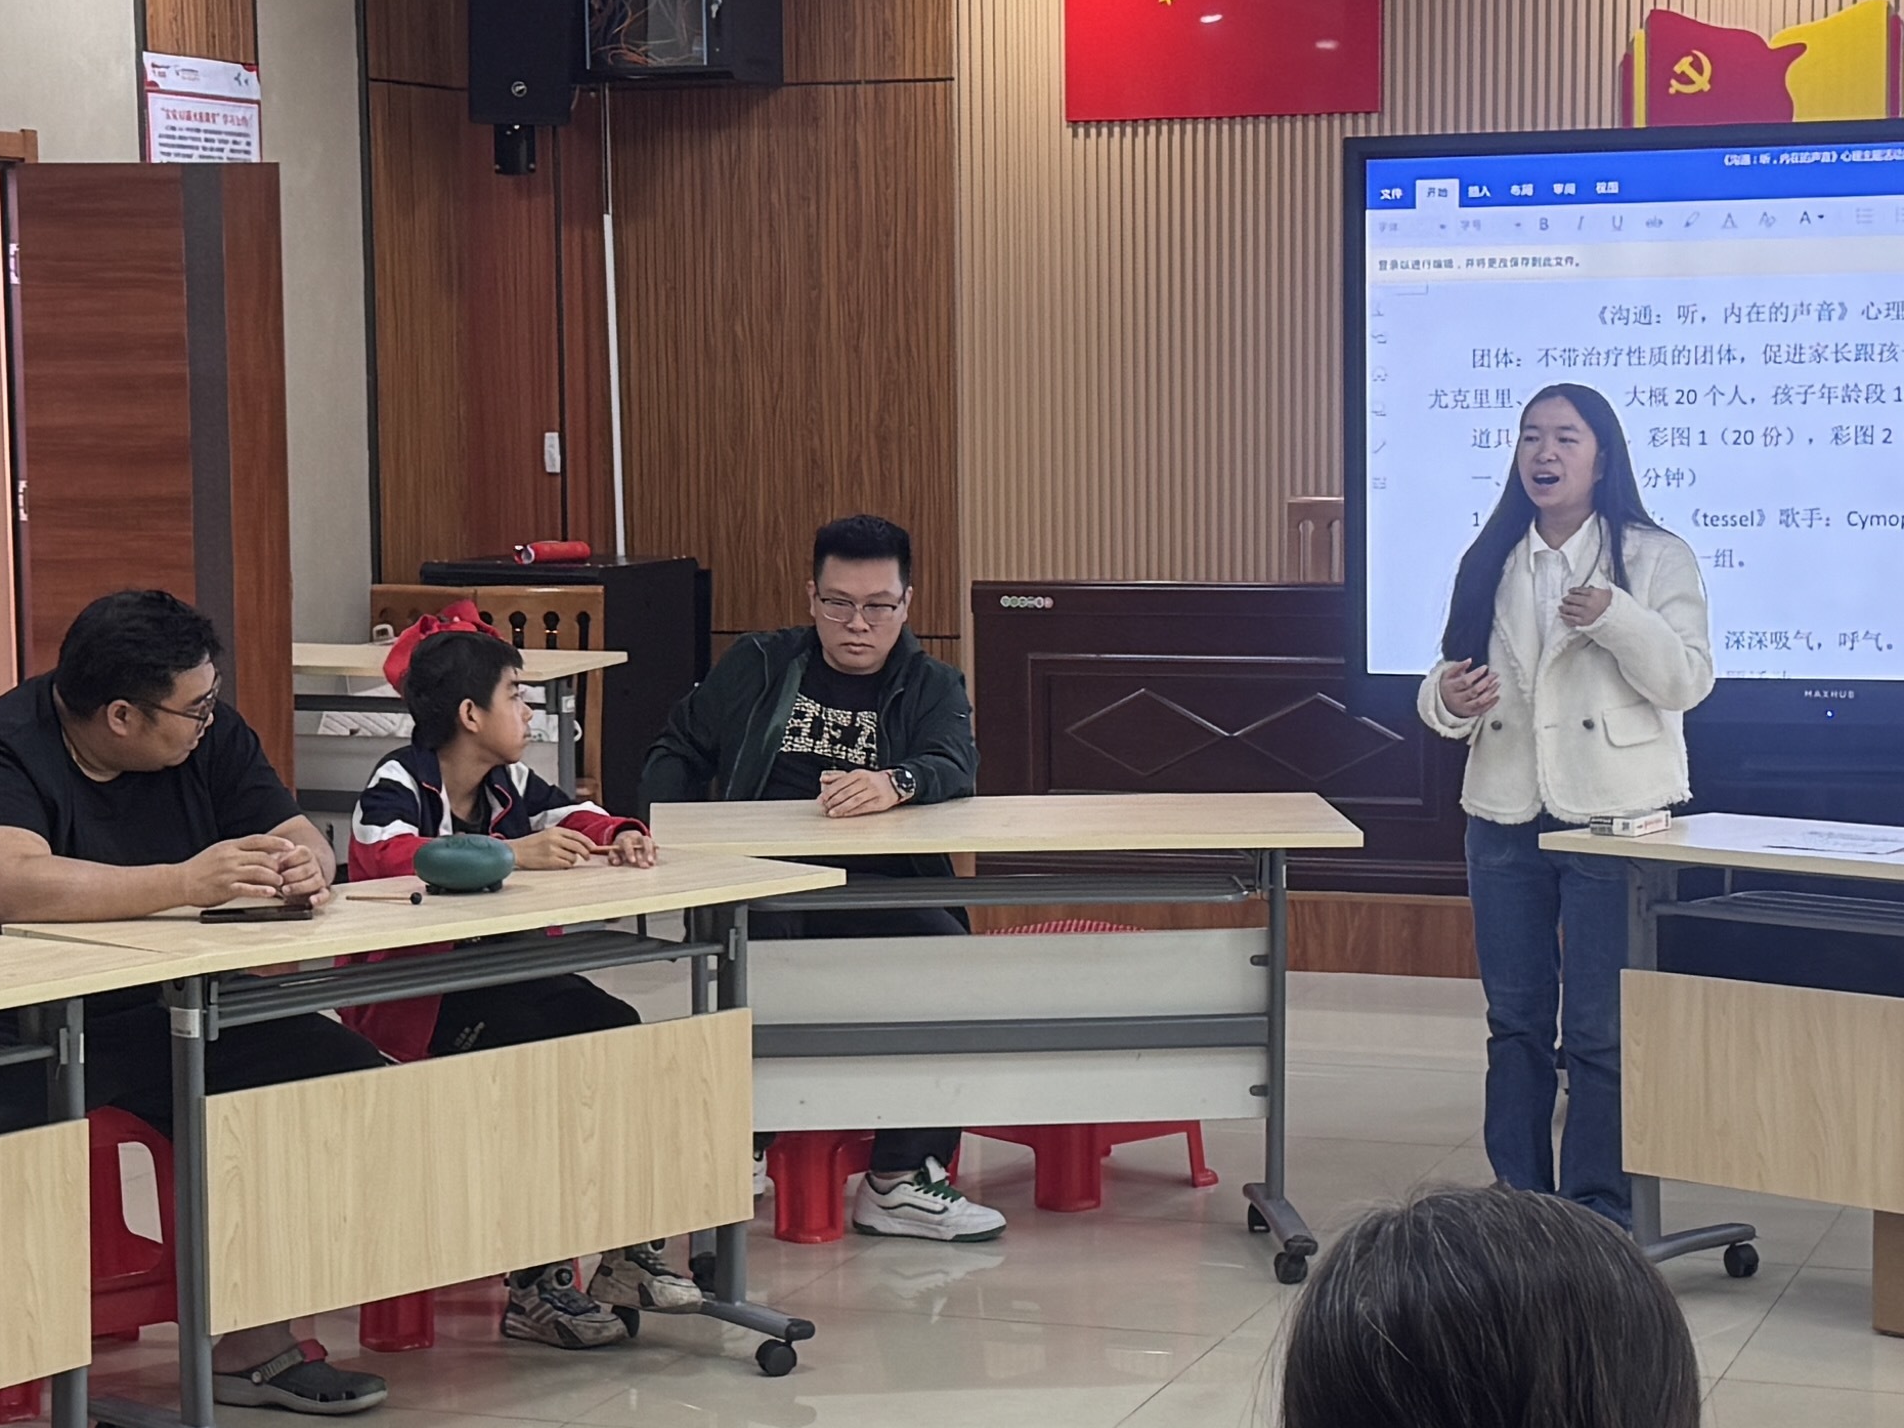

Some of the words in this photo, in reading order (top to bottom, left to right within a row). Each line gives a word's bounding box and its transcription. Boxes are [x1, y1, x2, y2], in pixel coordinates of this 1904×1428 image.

[1379, 187, 1403, 201] 文件
[1426, 186, 1448, 199] 开始
[1804, 689, 1856, 699] MAXHUB
